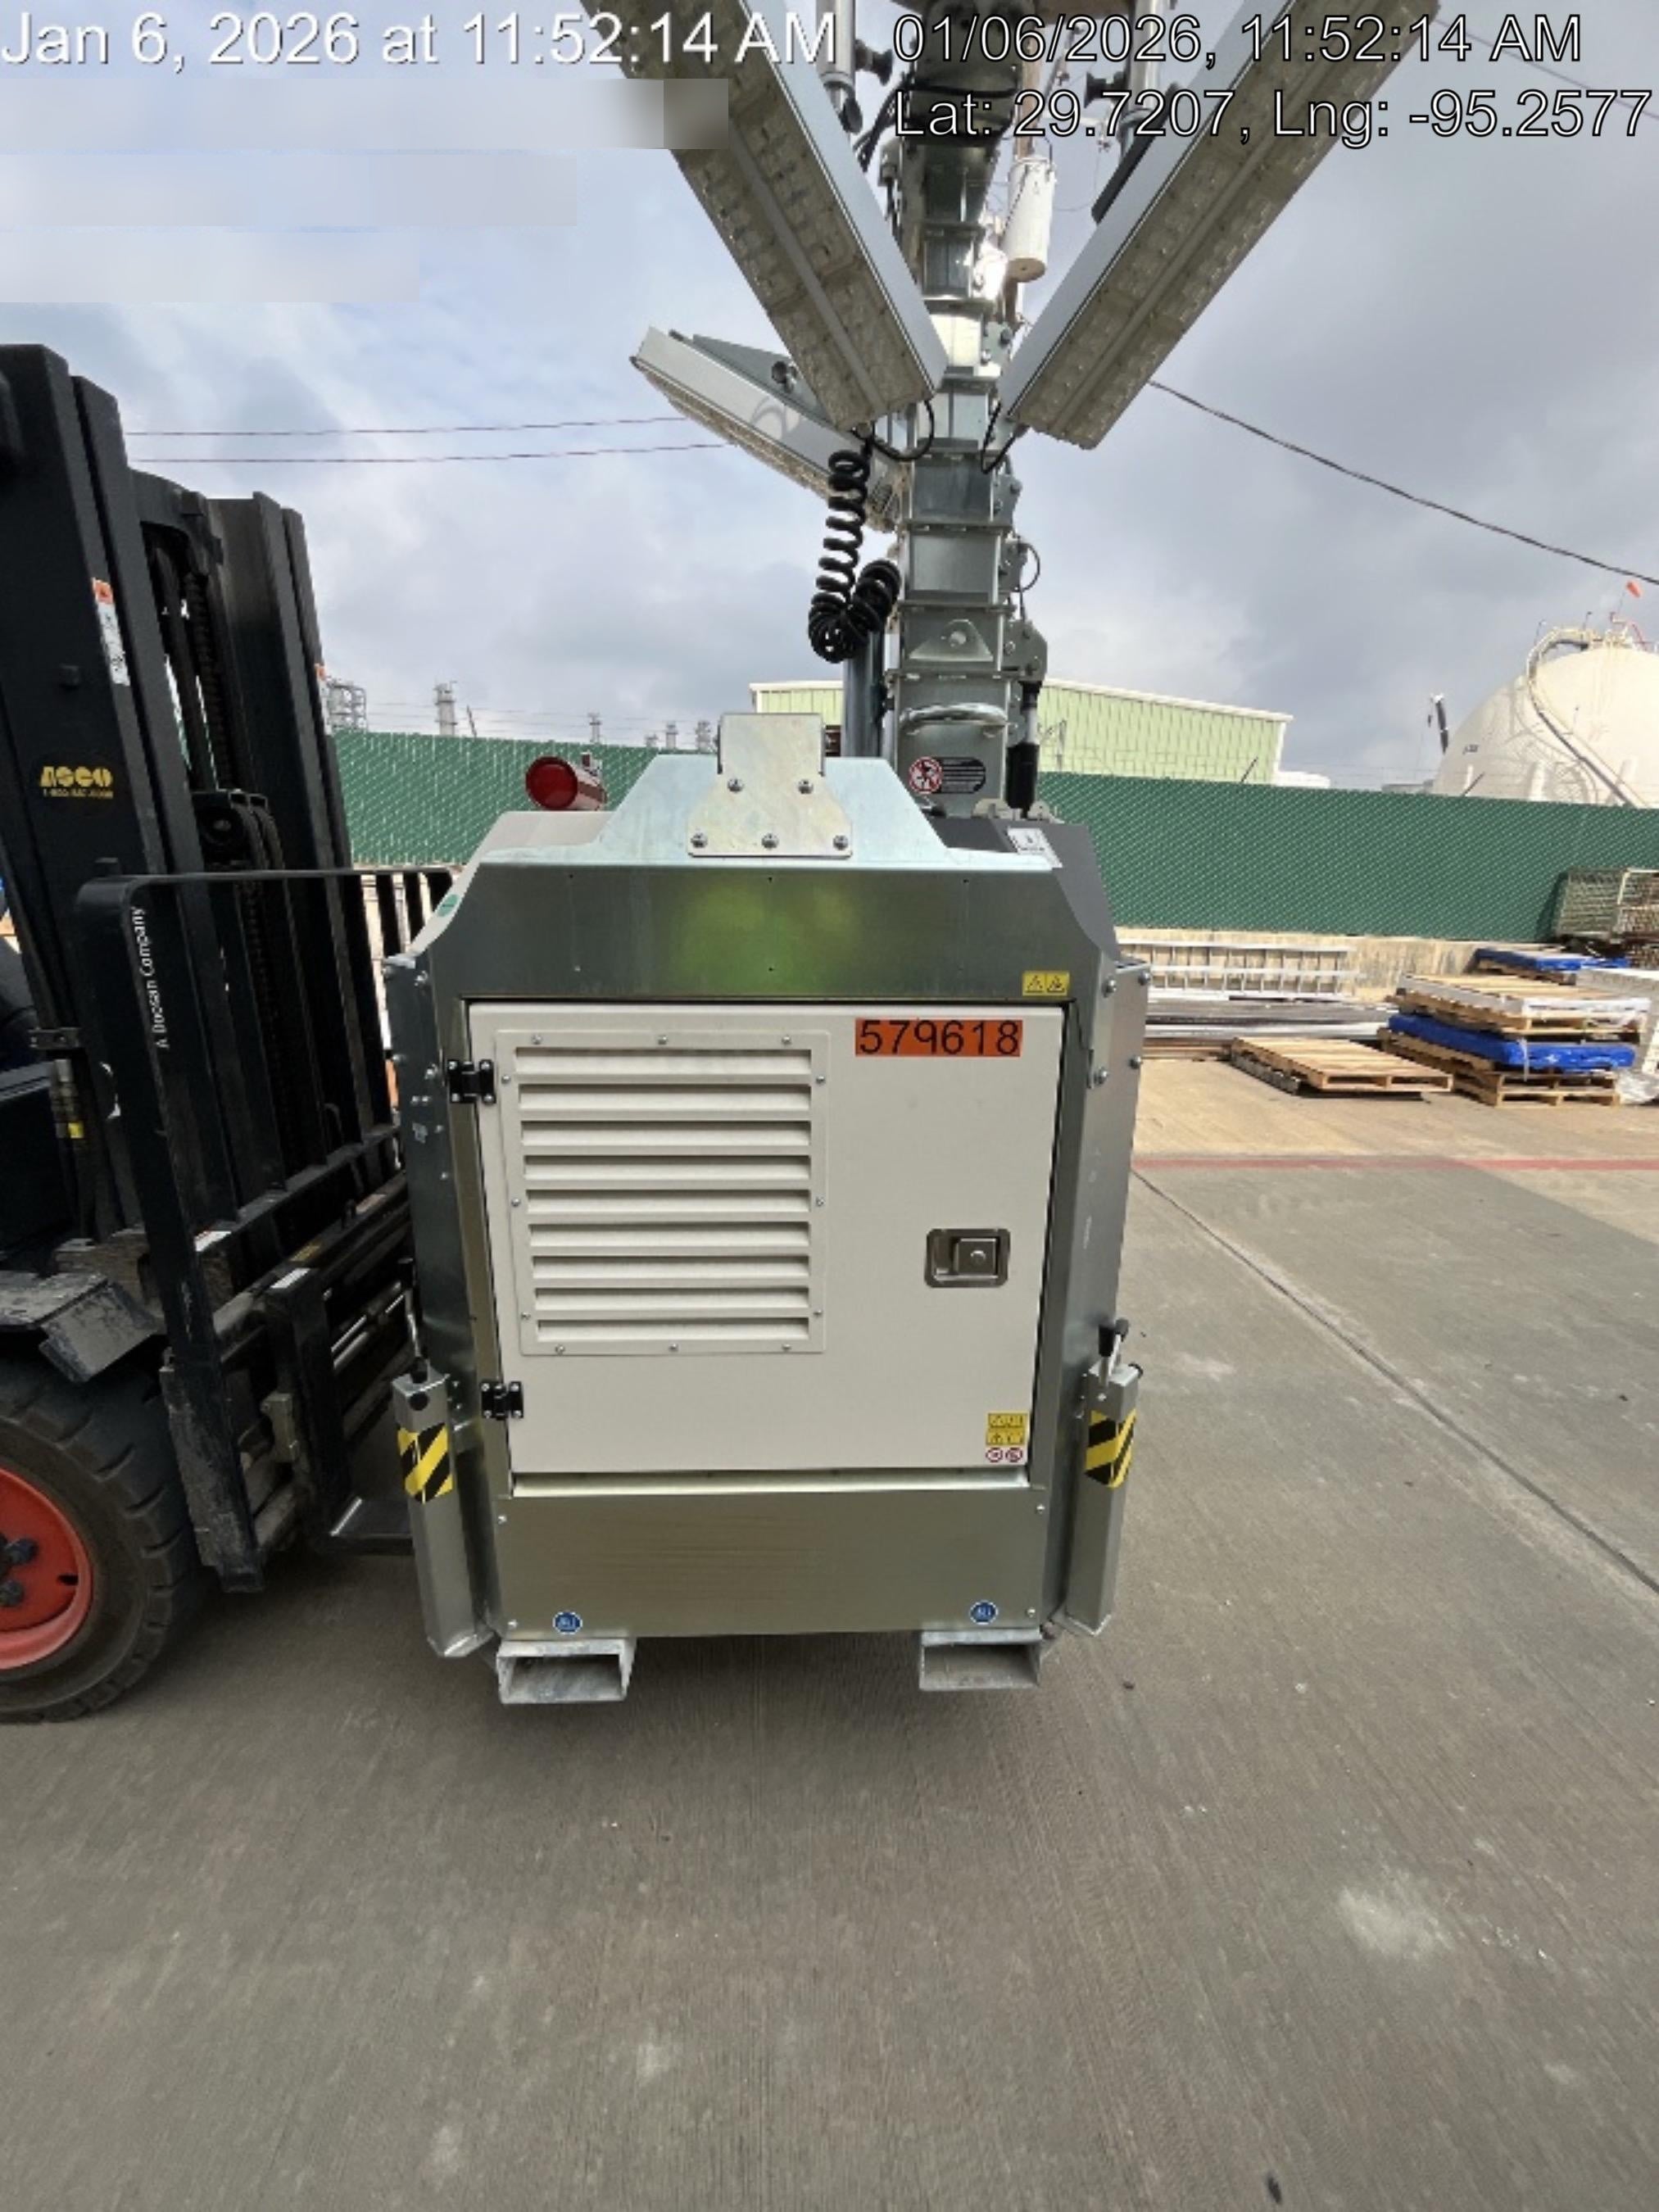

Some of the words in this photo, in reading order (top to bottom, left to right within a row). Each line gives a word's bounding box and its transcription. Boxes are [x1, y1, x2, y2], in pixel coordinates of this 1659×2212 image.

[130, 906, 155, 977] Company
[155, 1037, 170, 1050] A
[859, 1020, 1018, 1054] 579618
